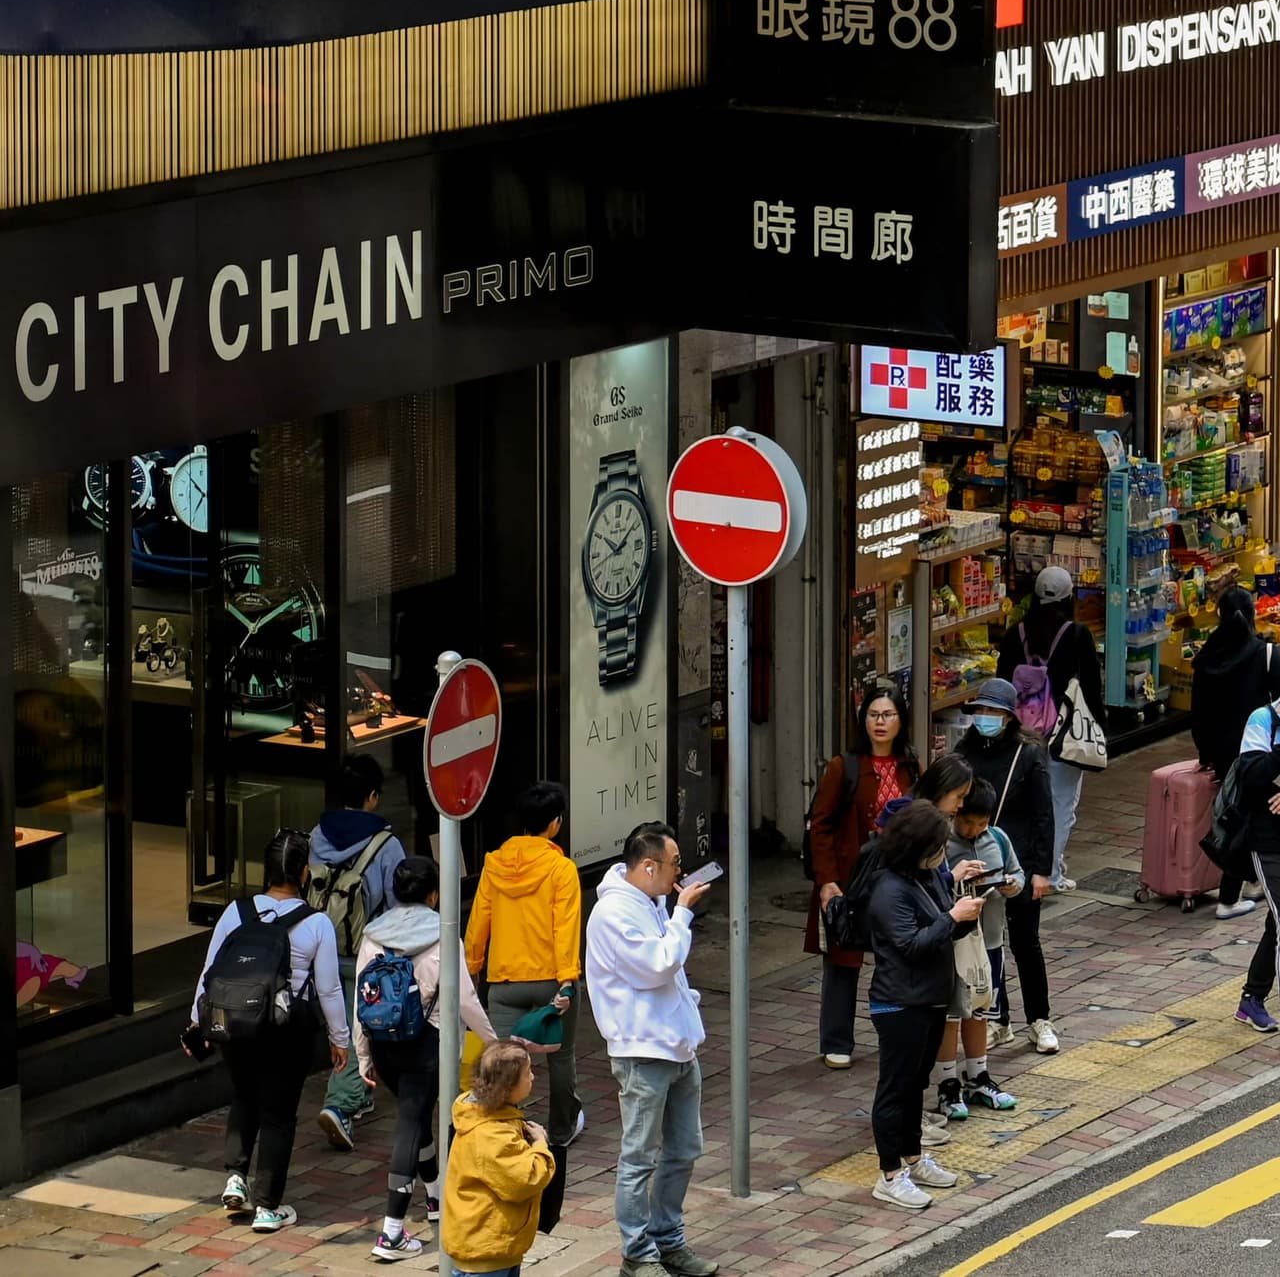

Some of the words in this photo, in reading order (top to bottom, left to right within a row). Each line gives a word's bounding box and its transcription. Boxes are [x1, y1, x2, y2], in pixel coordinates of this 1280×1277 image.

[995, 46, 1032, 96] AH
[1044, 32, 1105, 86] YAN
[1081, 169, 1176, 228] 中西醫藥
[753, 200, 914, 264] 時間廊
[15, 276, 185, 403] CITY
[208, 231, 423, 361] CHAIN
[443, 245, 594, 314] PRIMO
[593, 409, 618, 426] Grand
[621, 406, 643, 420] Seiko
[610, 386, 625, 406] GS
[936, 382, 995, 416] 服務
[36, 555, 100, 585] MUPPETS
[587, 703, 657, 747] ALIVE
[635, 739, 658, 769] IN
[597, 775, 657, 815] TIME
